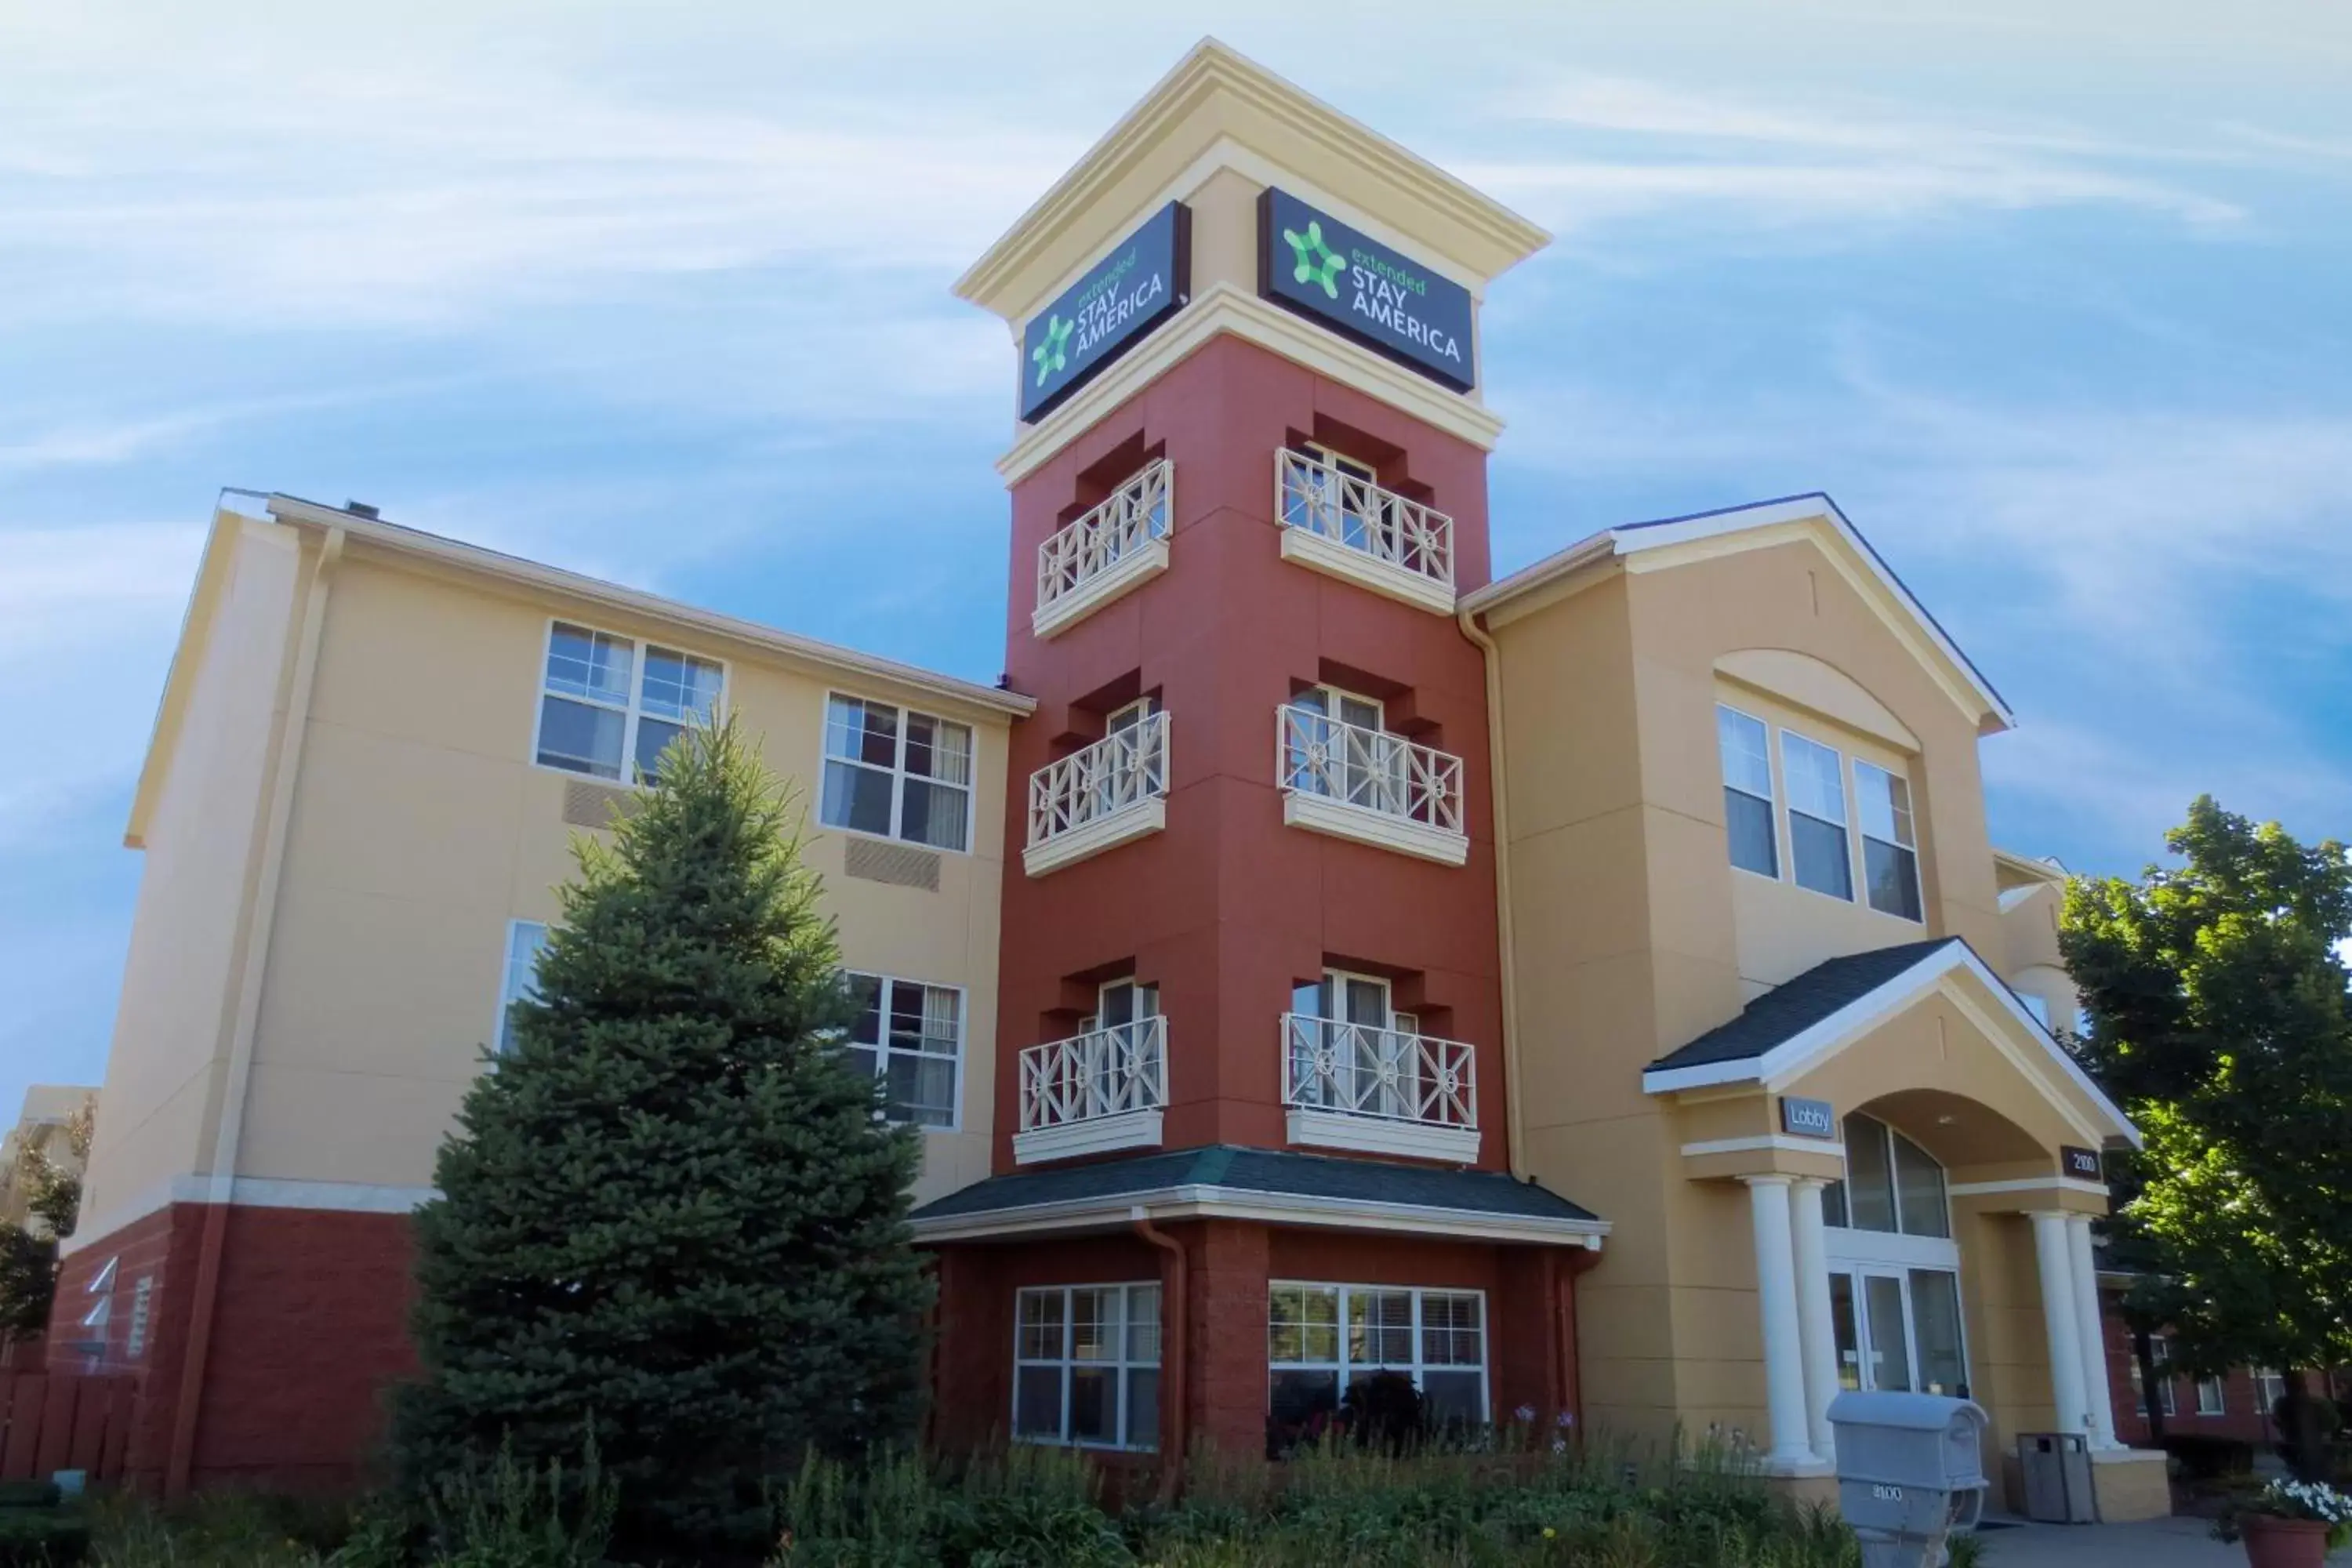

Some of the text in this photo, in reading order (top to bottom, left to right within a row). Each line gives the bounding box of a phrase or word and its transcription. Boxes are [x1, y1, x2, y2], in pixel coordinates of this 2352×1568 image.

[1078, 246, 1136, 308] extended
[1352, 249, 1427, 296] extended
[1352, 265, 1407, 310] STAY
[1076, 272, 1163, 358] AMERICA
[1077, 281, 1120, 333] STAY
[1352, 291, 1461, 363] AMERICA
[1790, 1103, 1829, 1132] Lobby
[2073, 1152, 2096, 1172] 2100
[1873, 1483, 1903, 1502] 2100
